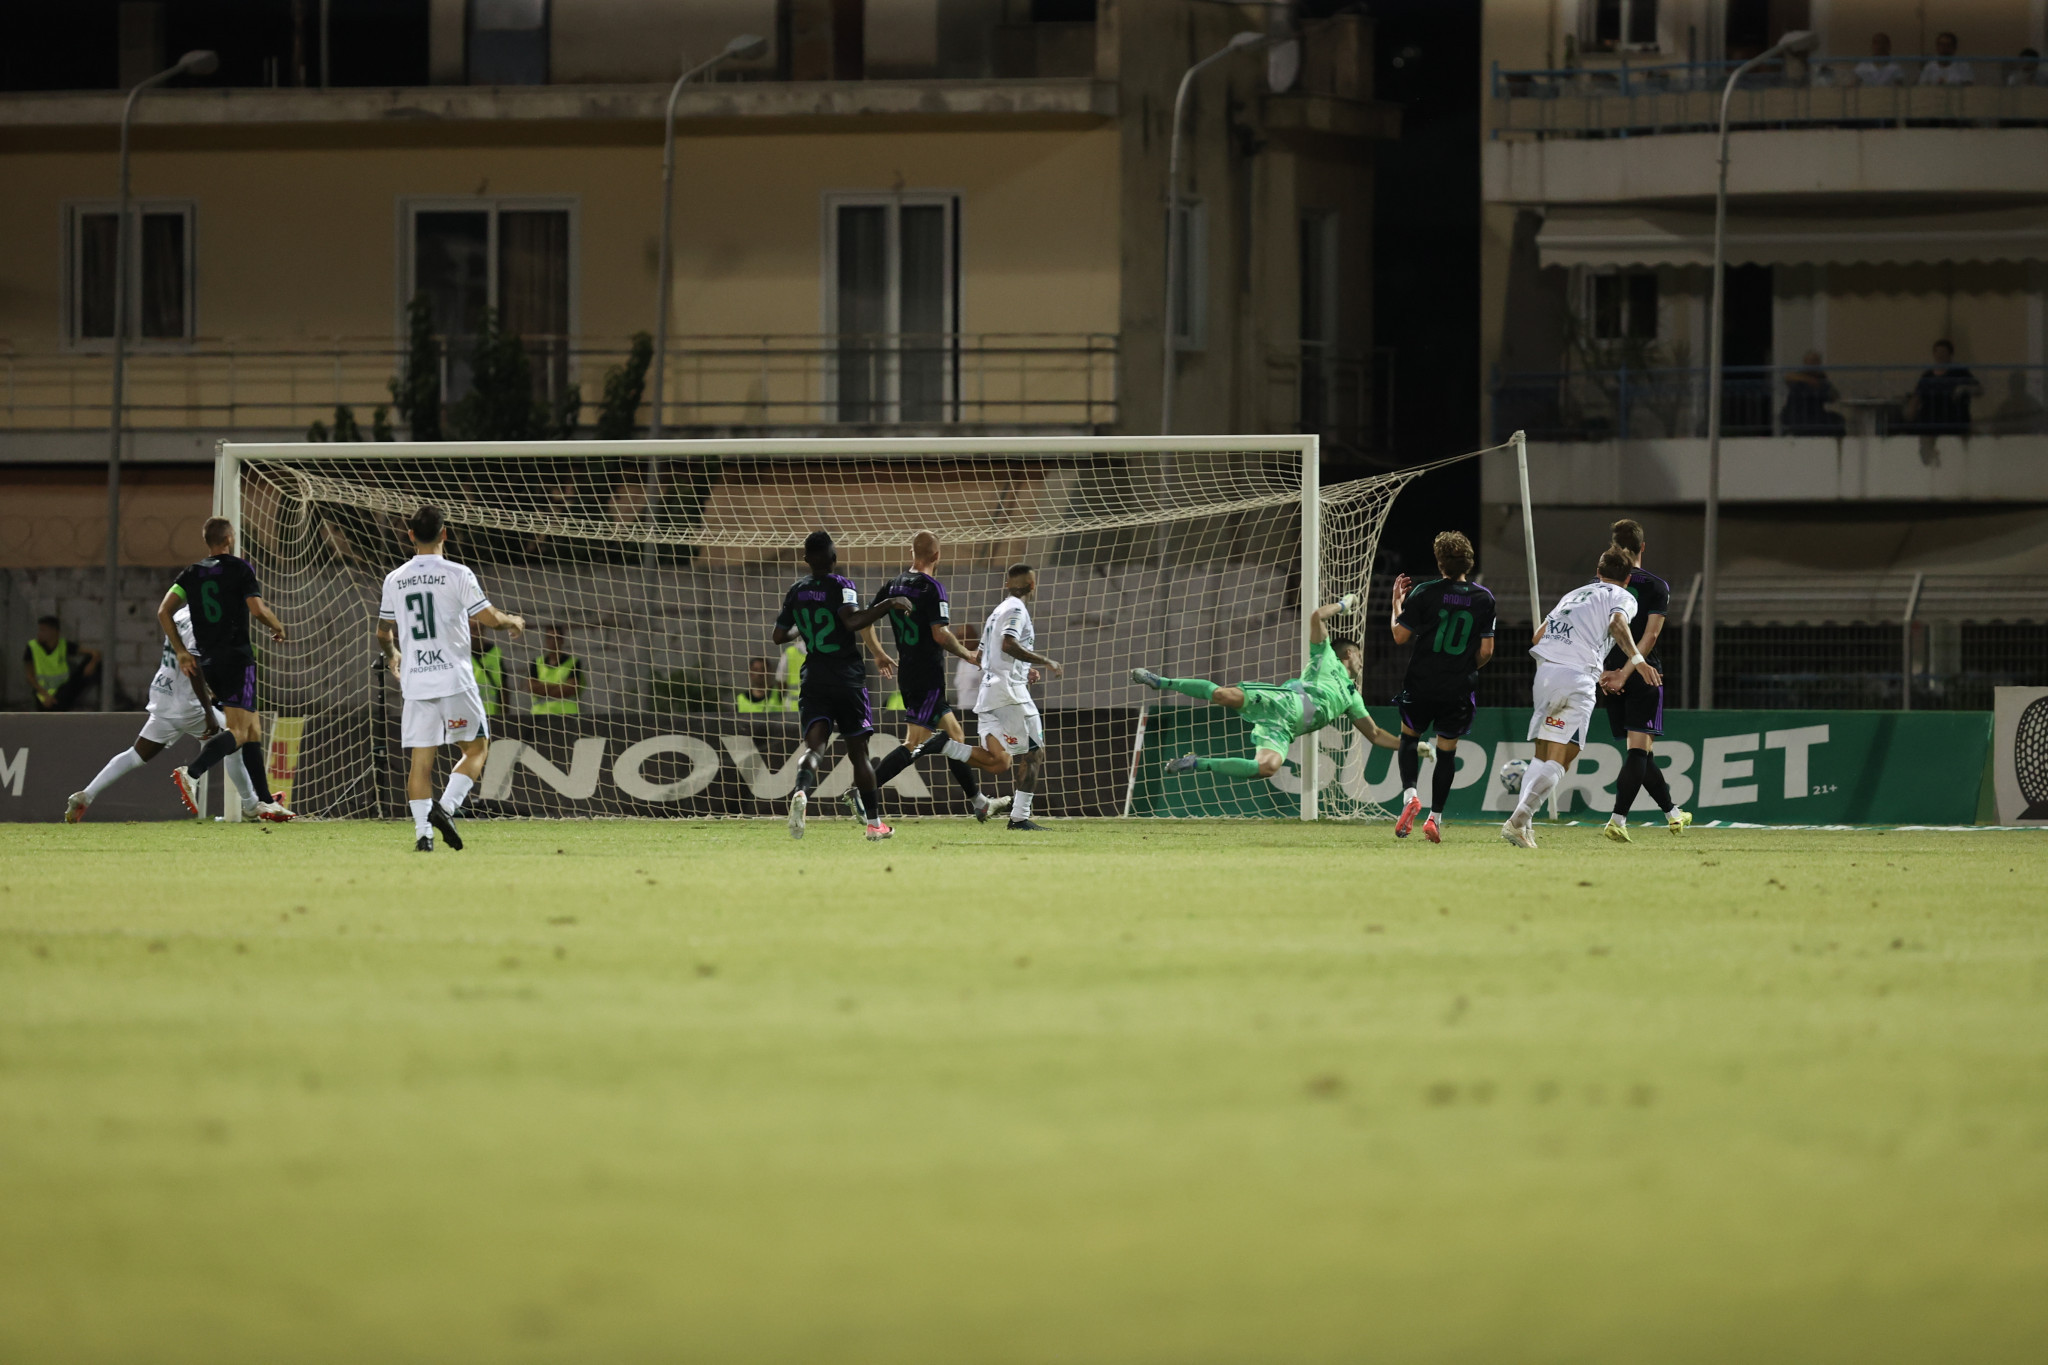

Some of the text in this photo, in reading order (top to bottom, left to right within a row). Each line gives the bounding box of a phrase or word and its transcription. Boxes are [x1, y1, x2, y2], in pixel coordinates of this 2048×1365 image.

[200, 580, 223, 624] 6
[405, 591, 435, 641] 31
[792, 607, 841, 654] 42
[1432, 608, 1474, 656] 10
[409, 662, 454, 674] PROPERTIES
[447, 717, 468, 729] Dole
[1545, 716, 1566, 729] Dole
[479, 734, 932, 802] NOVA
[1268, 724, 1830, 812] SUPERBET
[1812, 784, 1838, 796] 21+
